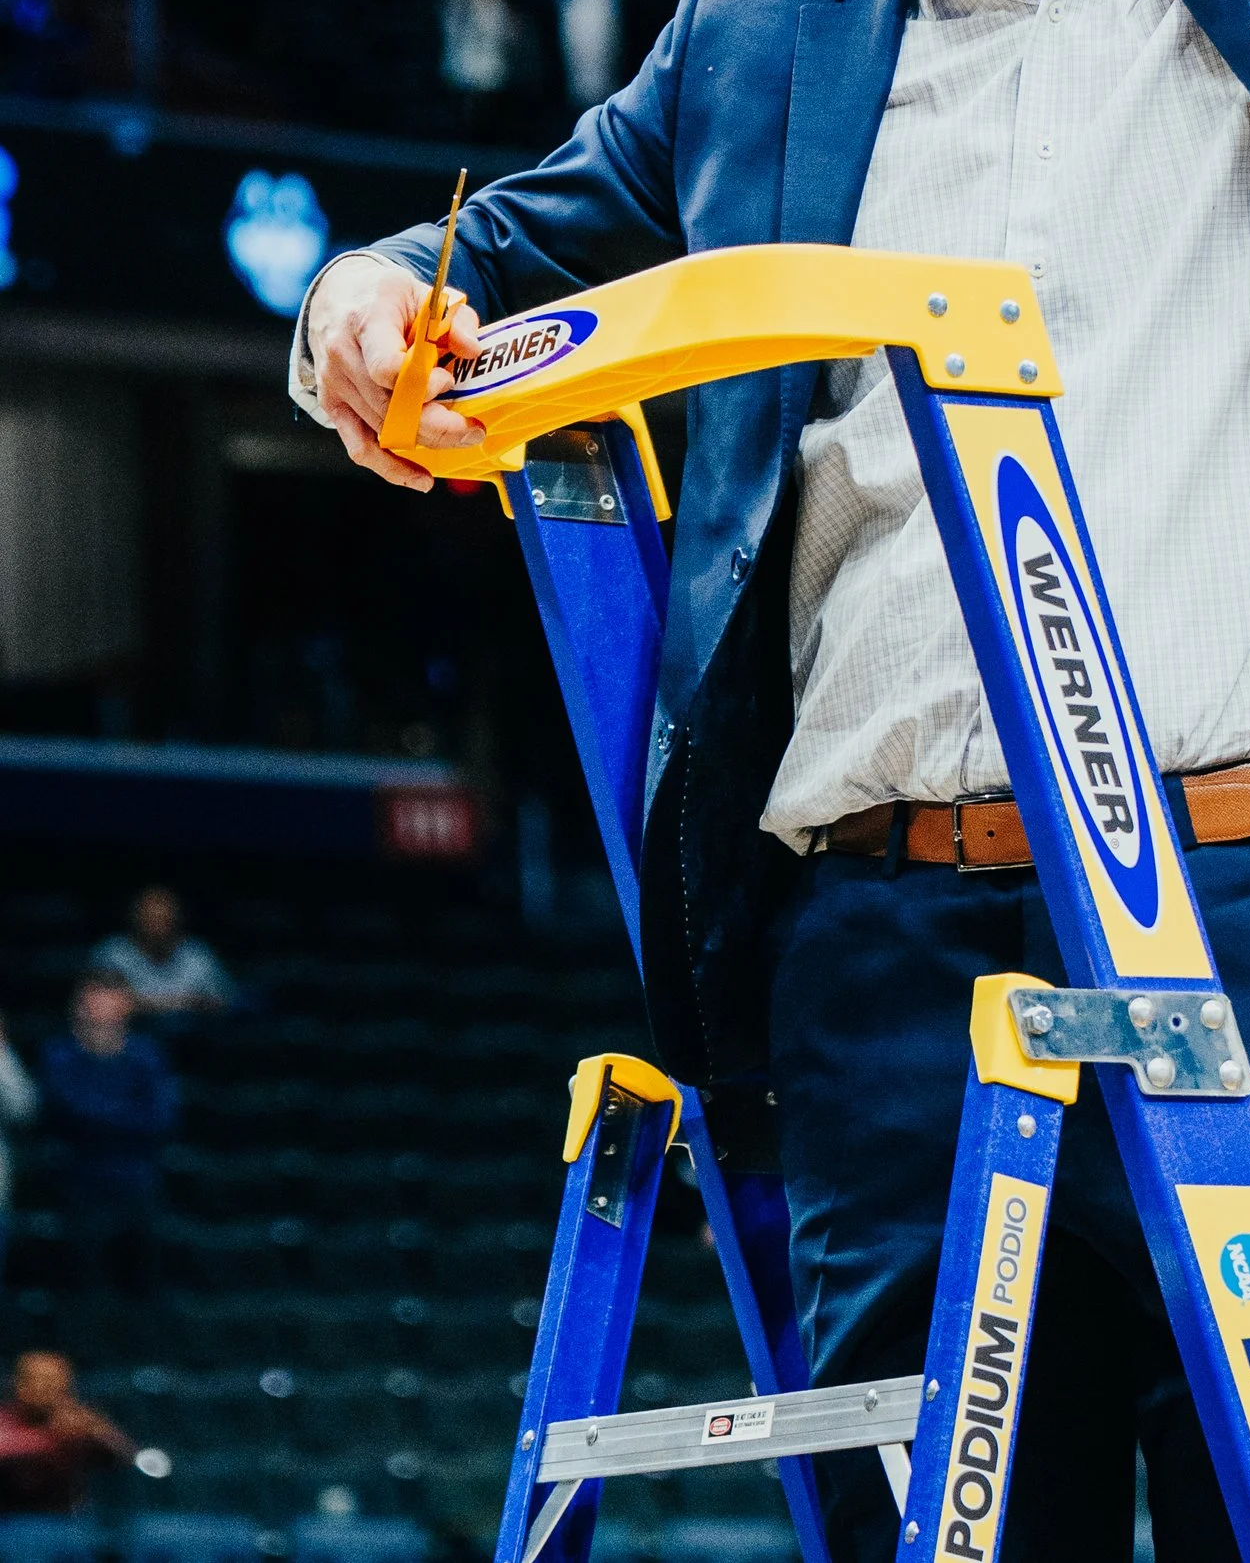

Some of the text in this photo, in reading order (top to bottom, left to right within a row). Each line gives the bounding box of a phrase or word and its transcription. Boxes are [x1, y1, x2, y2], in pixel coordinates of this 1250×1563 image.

[452, 323, 562, 386] WERNER
[1022, 551, 1135, 837] WERNER
[944, 1196, 1028, 1562] PODIUM PODIO
